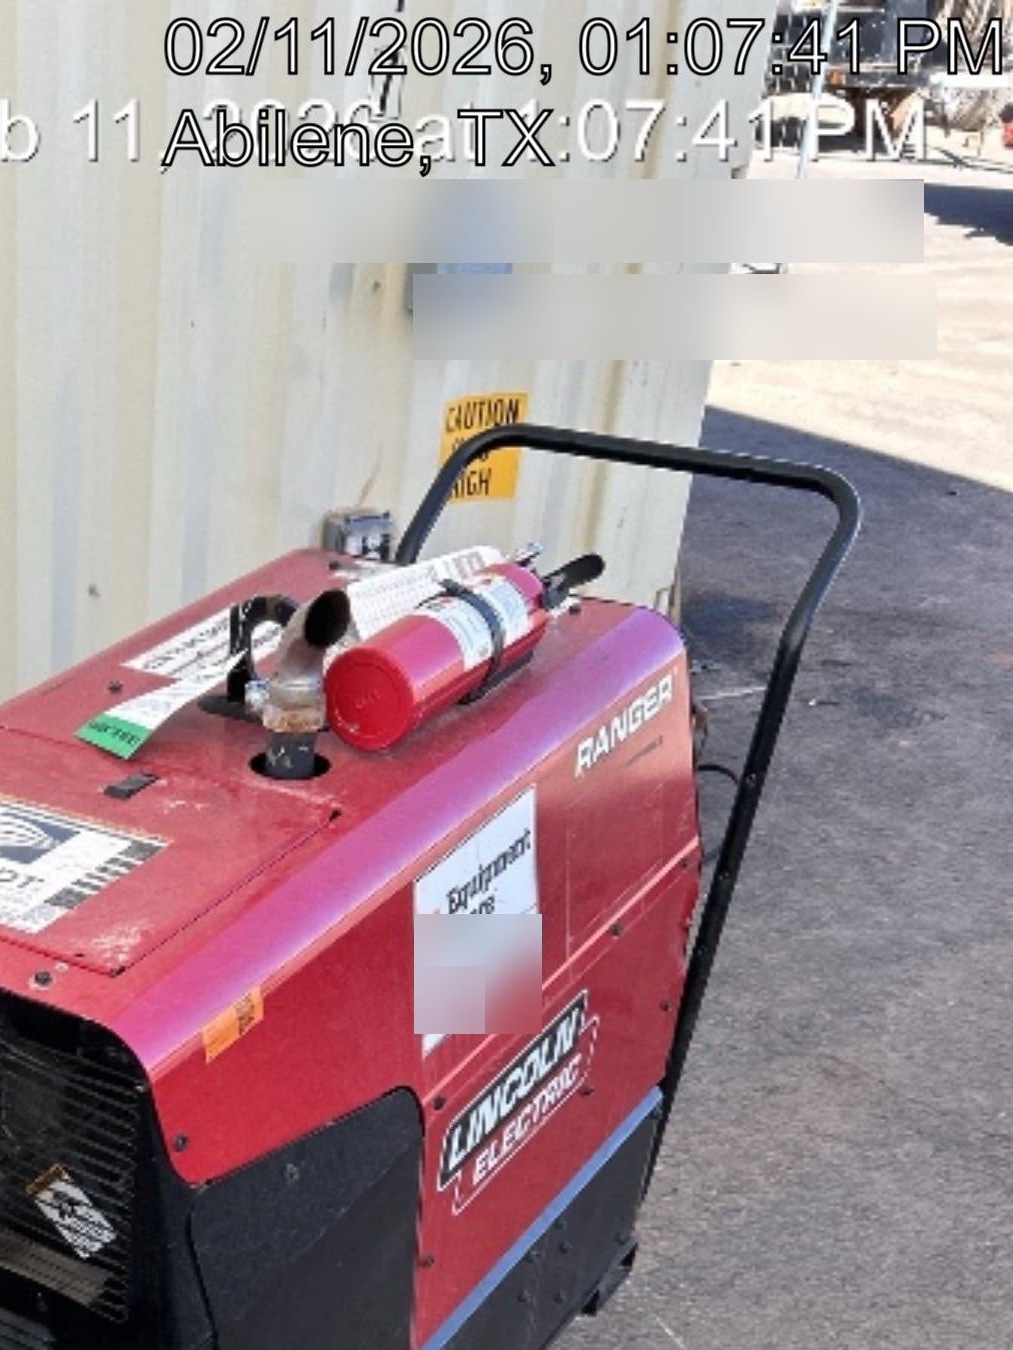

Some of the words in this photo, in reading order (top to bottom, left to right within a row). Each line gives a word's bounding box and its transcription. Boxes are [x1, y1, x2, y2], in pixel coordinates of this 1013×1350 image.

[446, 398, 519, 432] CAUTION
[574, 673, 672, 779] RANGER
[448, 1007, 580, 1173] LINCOLN
[472, 1052, 582, 1186] ELECTRIC
